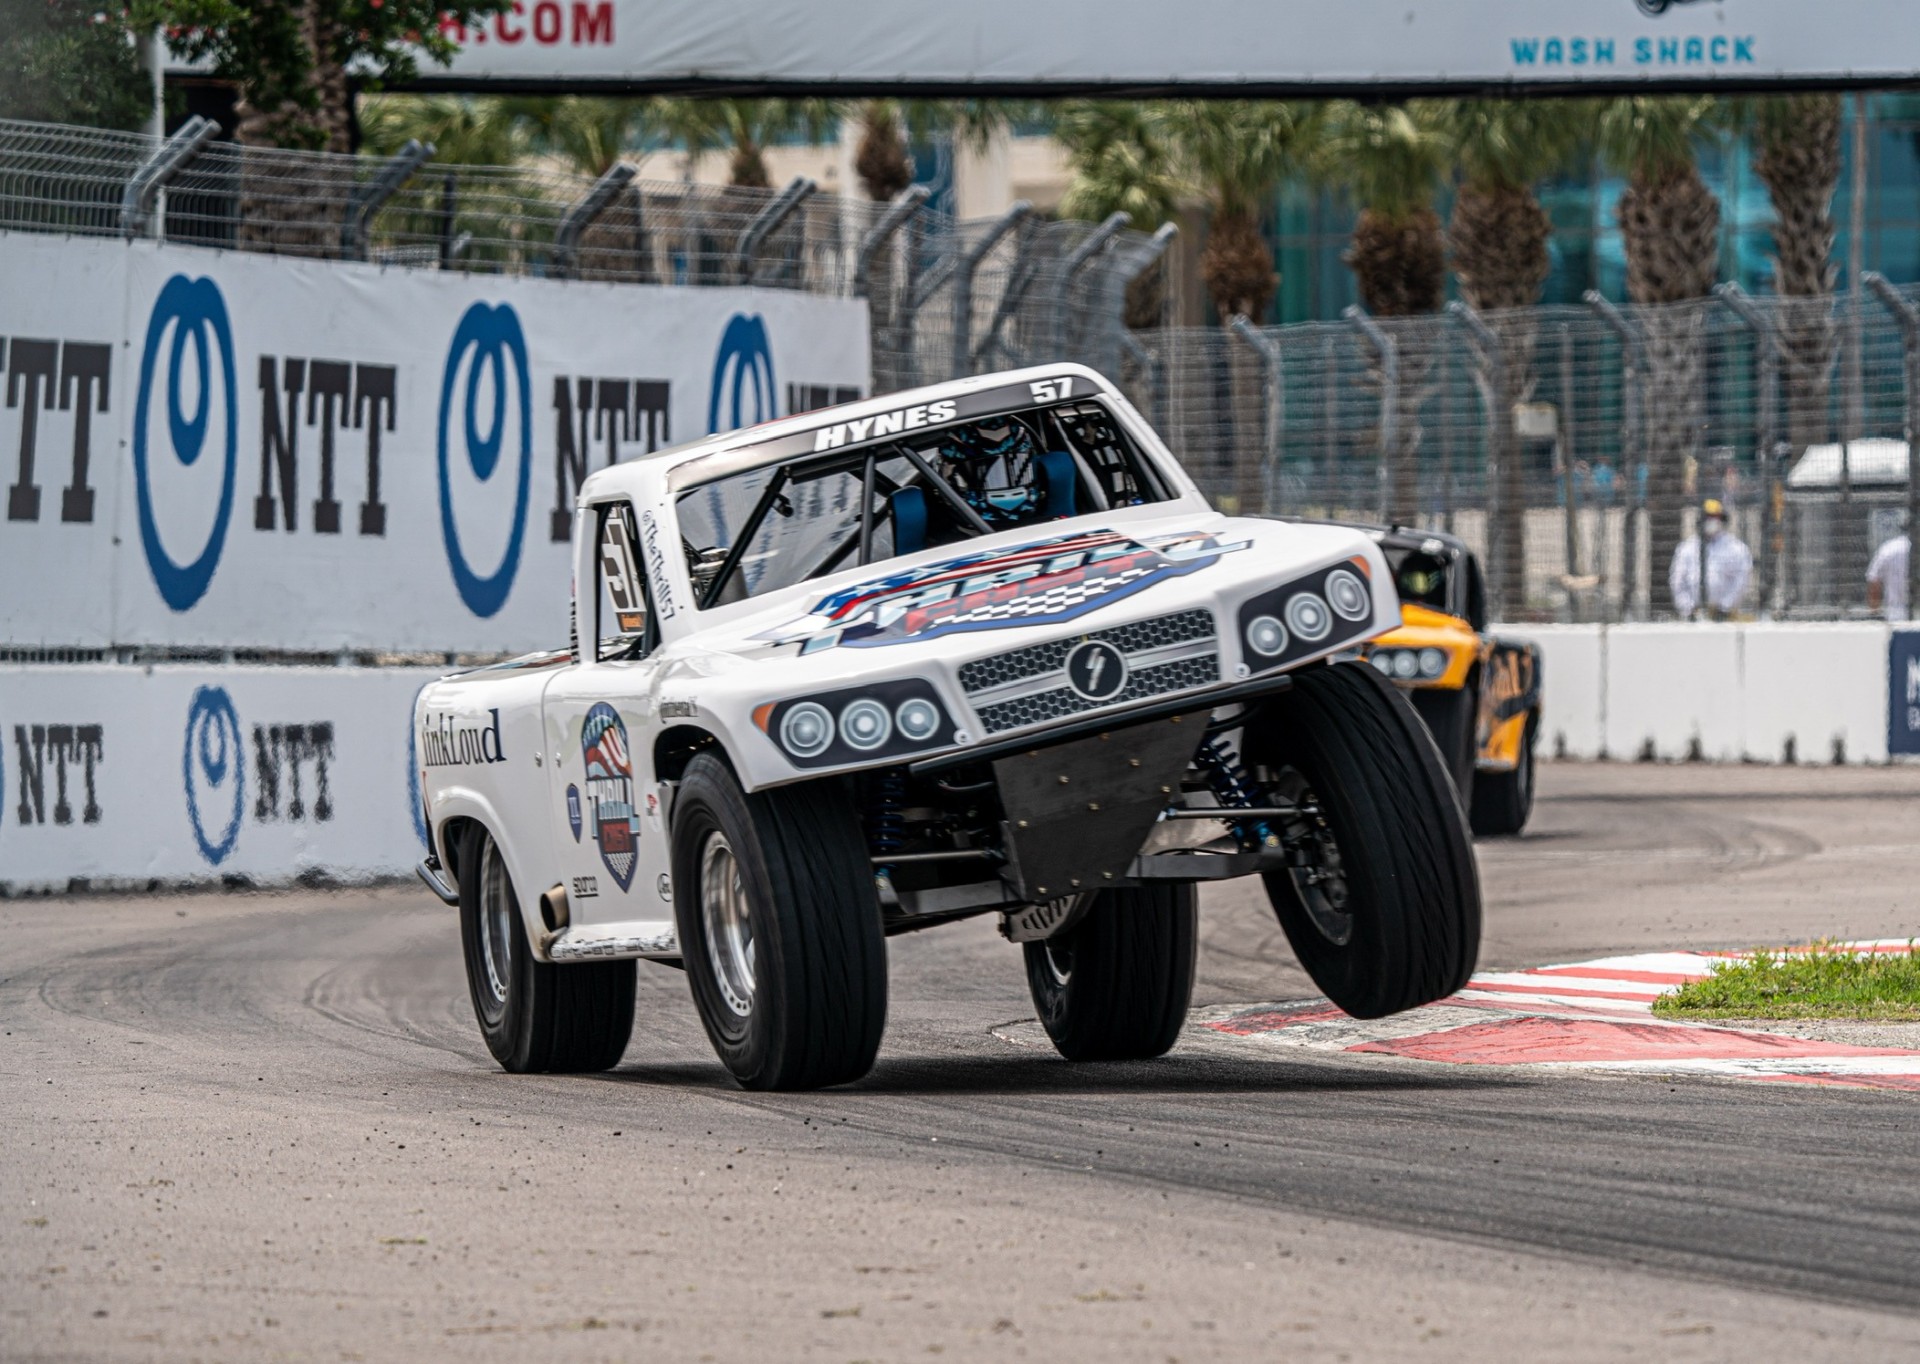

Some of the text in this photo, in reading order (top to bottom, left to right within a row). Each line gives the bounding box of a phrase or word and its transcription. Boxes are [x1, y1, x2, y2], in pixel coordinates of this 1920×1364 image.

[1510, 36, 1755, 65] WASH SHACK
[0, 336, 112, 523] TT
[814, 400, 957, 452] HYNES
[1029, 377, 1073, 403] 57
[254, 354, 397, 537] NTT
[14, 723, 103, 825] NTT
[252, 720, 335, 822] NTT
